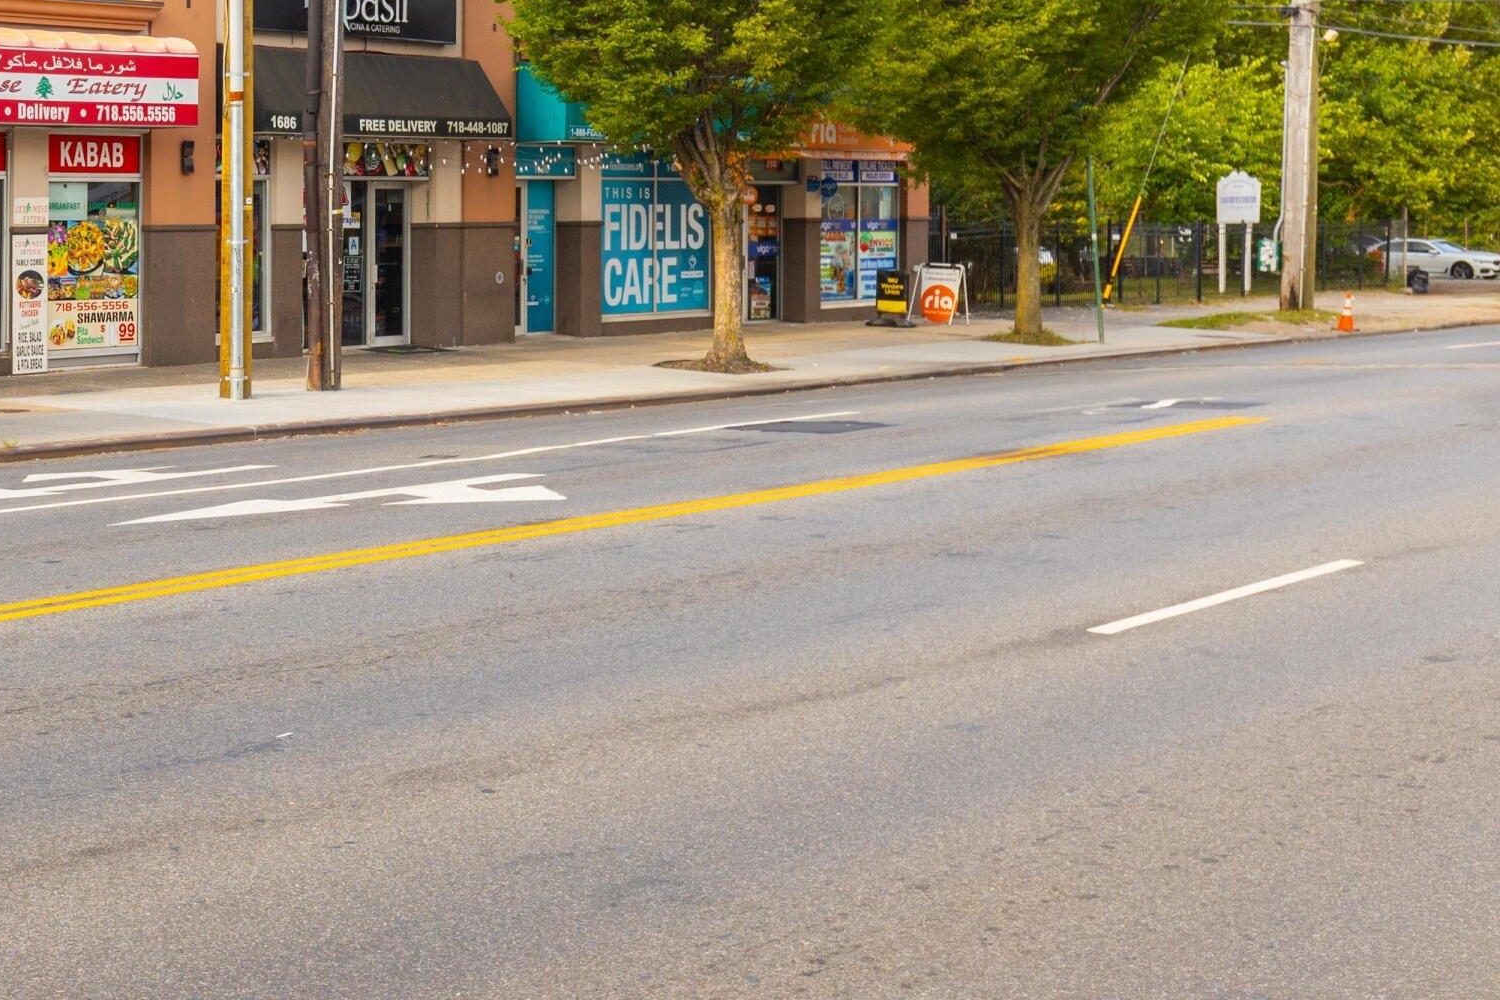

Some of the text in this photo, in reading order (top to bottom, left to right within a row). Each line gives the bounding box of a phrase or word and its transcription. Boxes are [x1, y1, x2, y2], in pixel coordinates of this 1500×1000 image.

[370, 24, 400, 33] CATERING
[67, 77, 148, 103] Eatery
[18, 103, 70, 122] Delivery
[95, 104, 176, 122] 718.556.5556
[270, 115, 297, 130] 1686
[359, 118, 509, 134] FREE DELIVERY 718-448-1087
[59, 140, 124, 168] KABAB
[604, 186, 651, 199] THIS IS
[603, 202, 705, 251] FIDELIS
[350, 239, 357, 249] A
[603, 256, 678, 307] CARE
[55, 301, 129, 312] 718-556-5556
[924, 288, 953, 310] ria
[76, 311, 134, 324] SHAWARMA
[76, 326, 88, 335] Pita
[118, 322, 136, 338] 99
[76, 335, 105, 345] Sandwich
